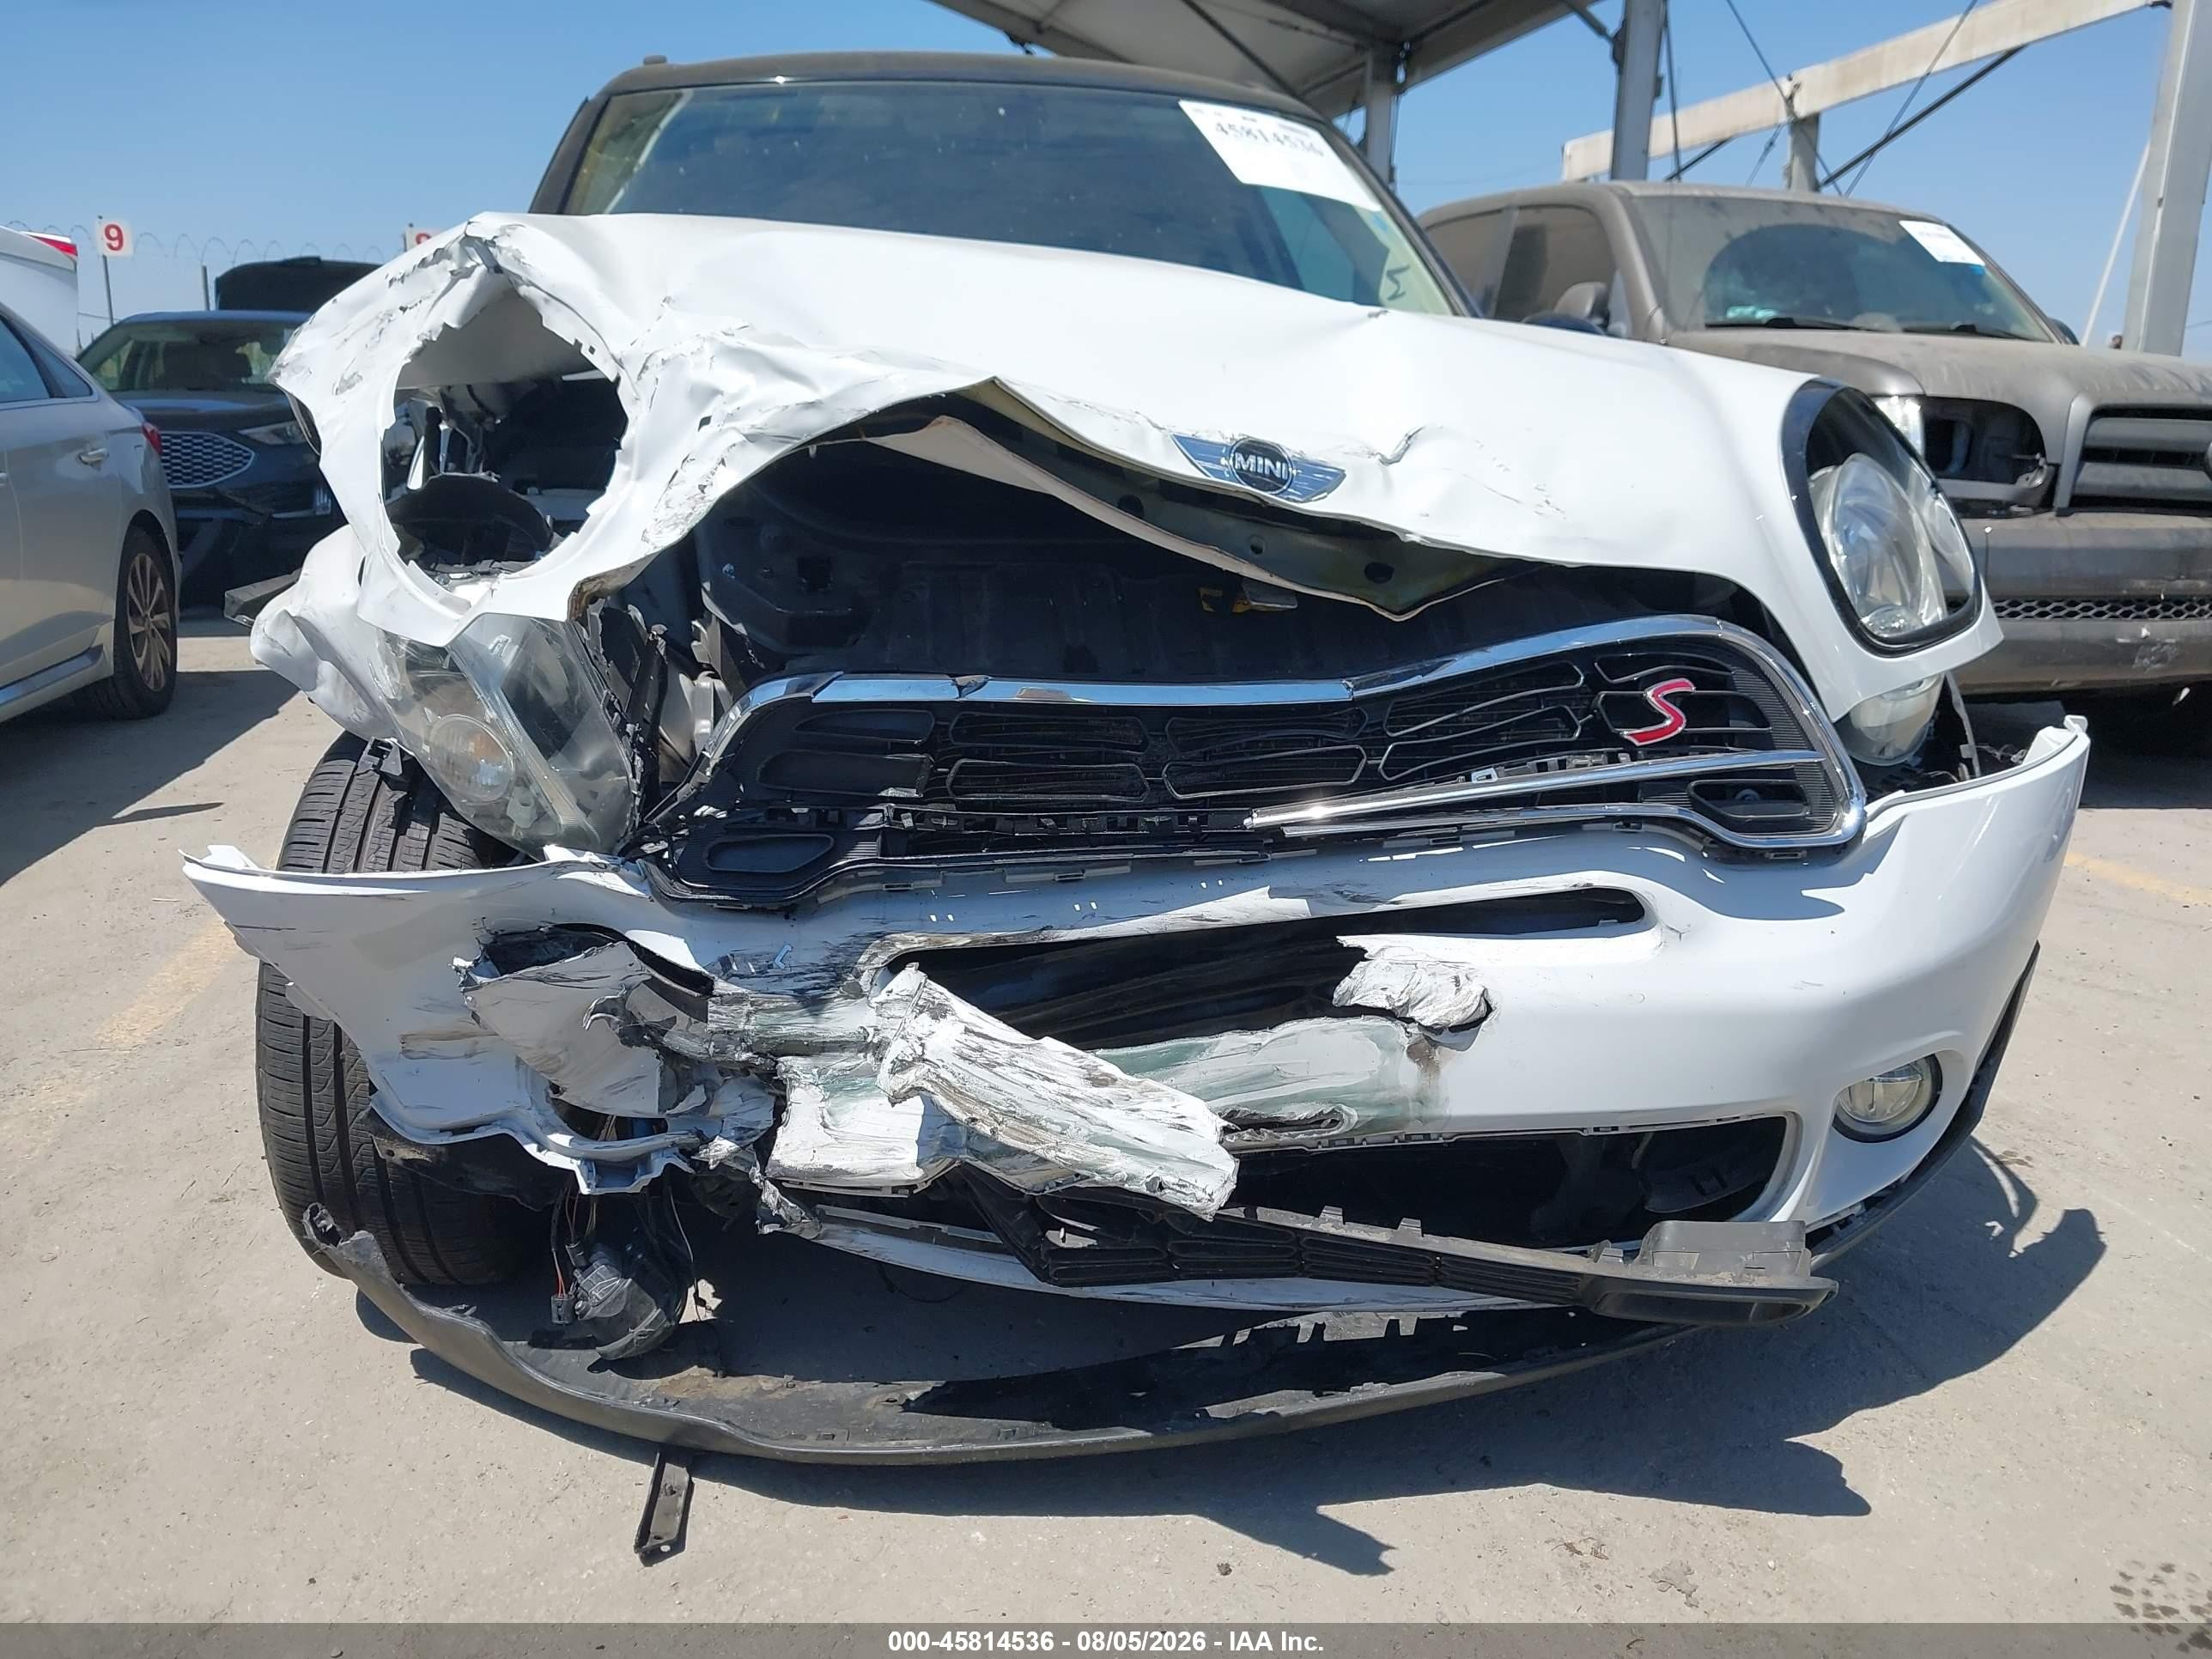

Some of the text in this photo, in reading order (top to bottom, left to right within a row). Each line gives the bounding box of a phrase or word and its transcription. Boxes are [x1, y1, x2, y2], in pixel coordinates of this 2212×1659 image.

[104, 223, 124, 251] 9
[1234, 453, 1288, 480] MINI
[1620, 678, 1696, 746] S
